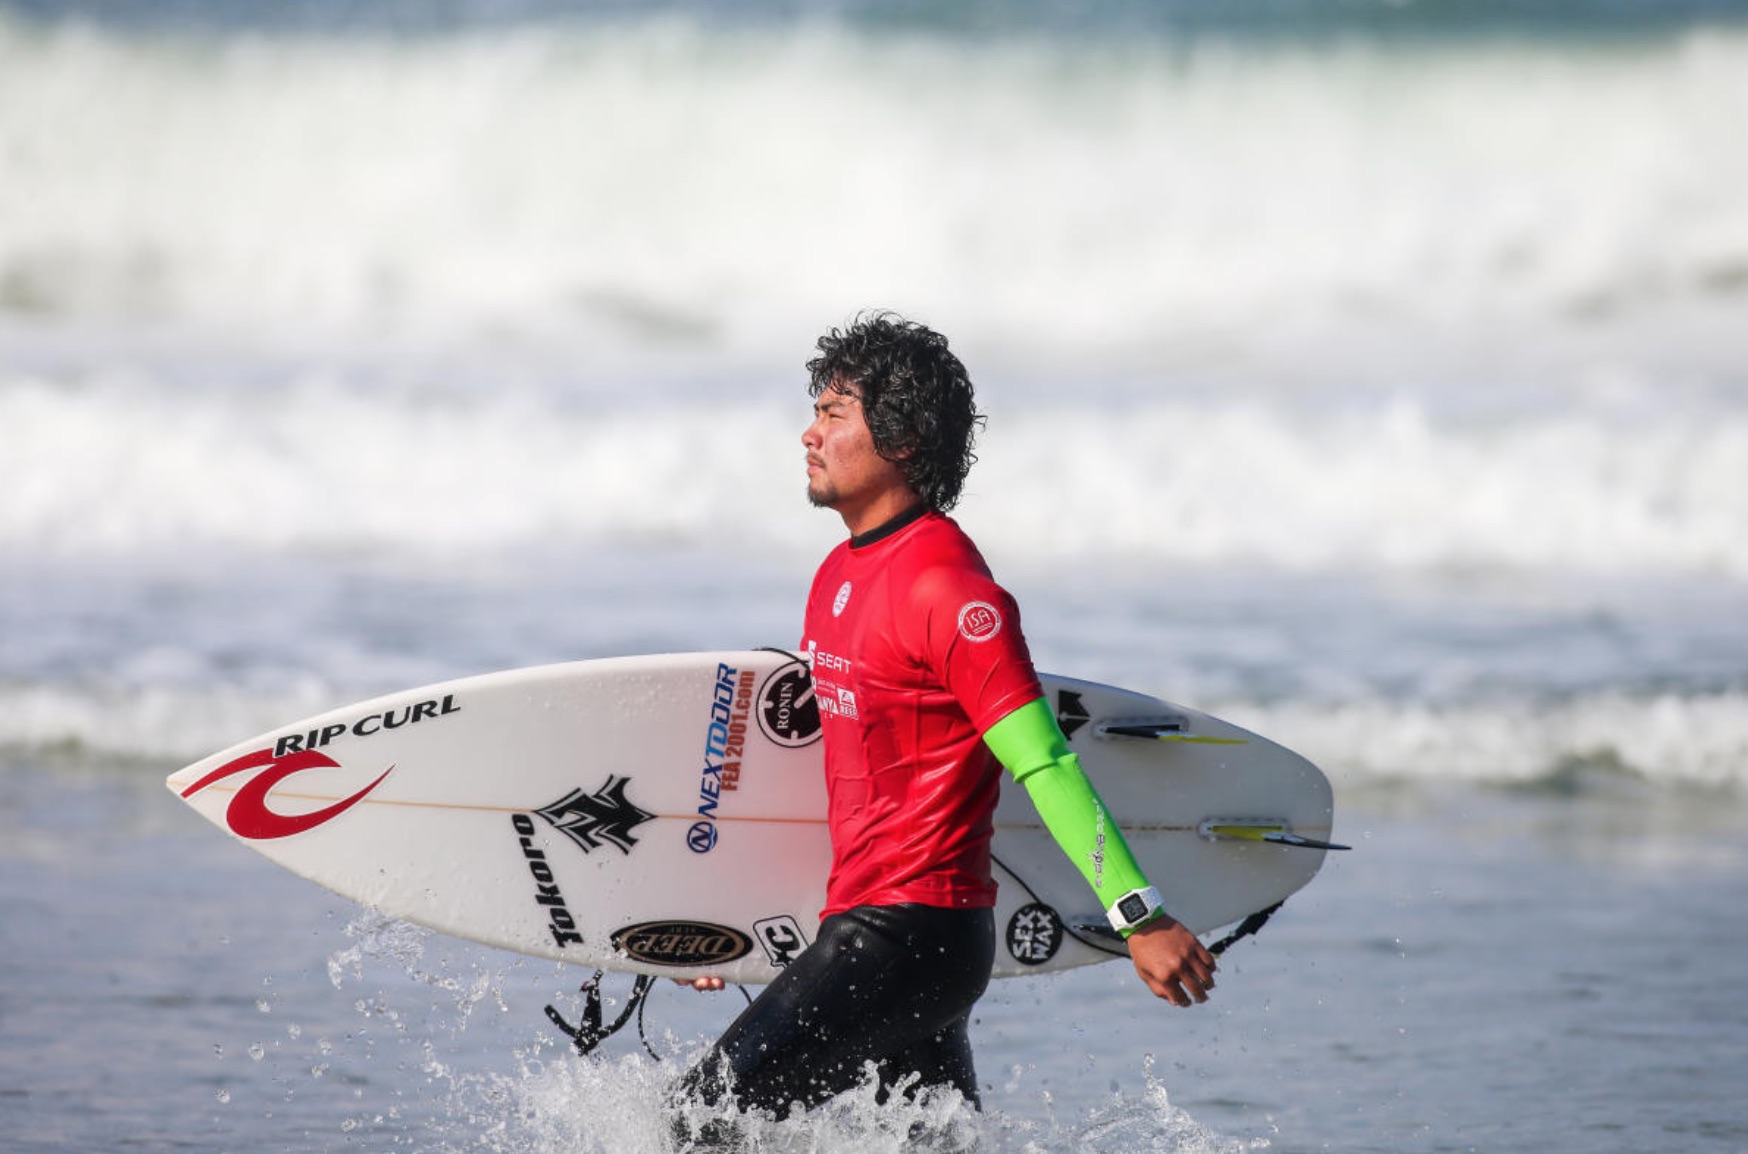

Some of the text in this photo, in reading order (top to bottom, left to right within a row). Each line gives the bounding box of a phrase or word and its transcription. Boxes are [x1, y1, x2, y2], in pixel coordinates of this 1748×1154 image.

[965, 610, 991, 629] ISA
[817, 651, 853, 674] SEAT
[275, 694, 461, 757] RIP CURL
[777, 682, 794, 730] RONIN
[698, 662, 737, 820] NEXTDOOR
[720, 671, 755, 791] FEA 2001.com
[631, 934, 730, 955] DEEP
[1012, 910, 1036, 958] SEX
[1032, 911, 1054, 959] WAX
